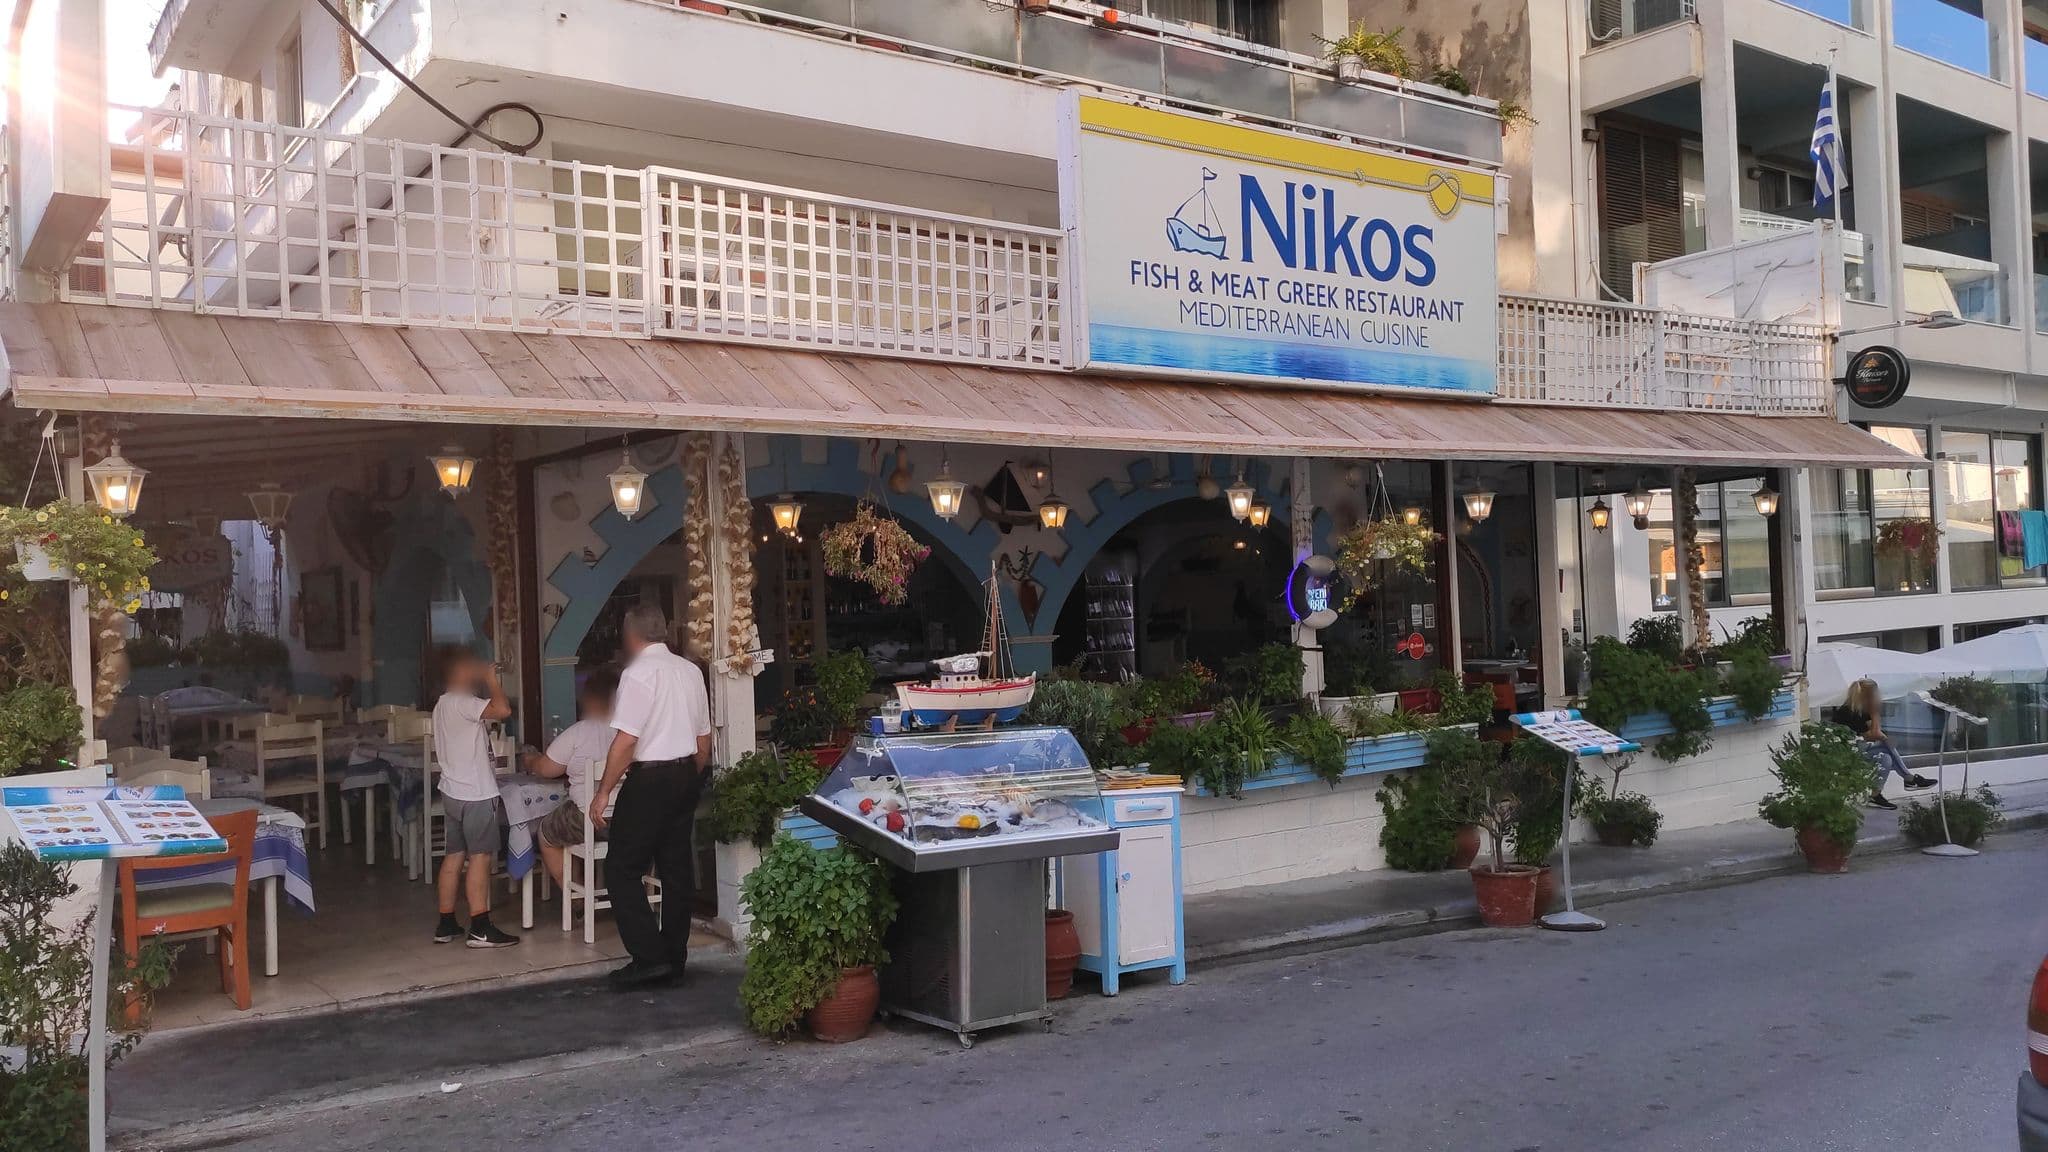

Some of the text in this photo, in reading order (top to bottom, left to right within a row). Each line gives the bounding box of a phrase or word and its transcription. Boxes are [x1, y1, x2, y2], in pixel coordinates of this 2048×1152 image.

[1239, 173, 1437, 287] Nikos
[1130, 259, 1465, 323] FISH & MEAT GREEK RESTAURANT
[1179, 299, 1430, 349] MEDITERRANEAN CUISINE
